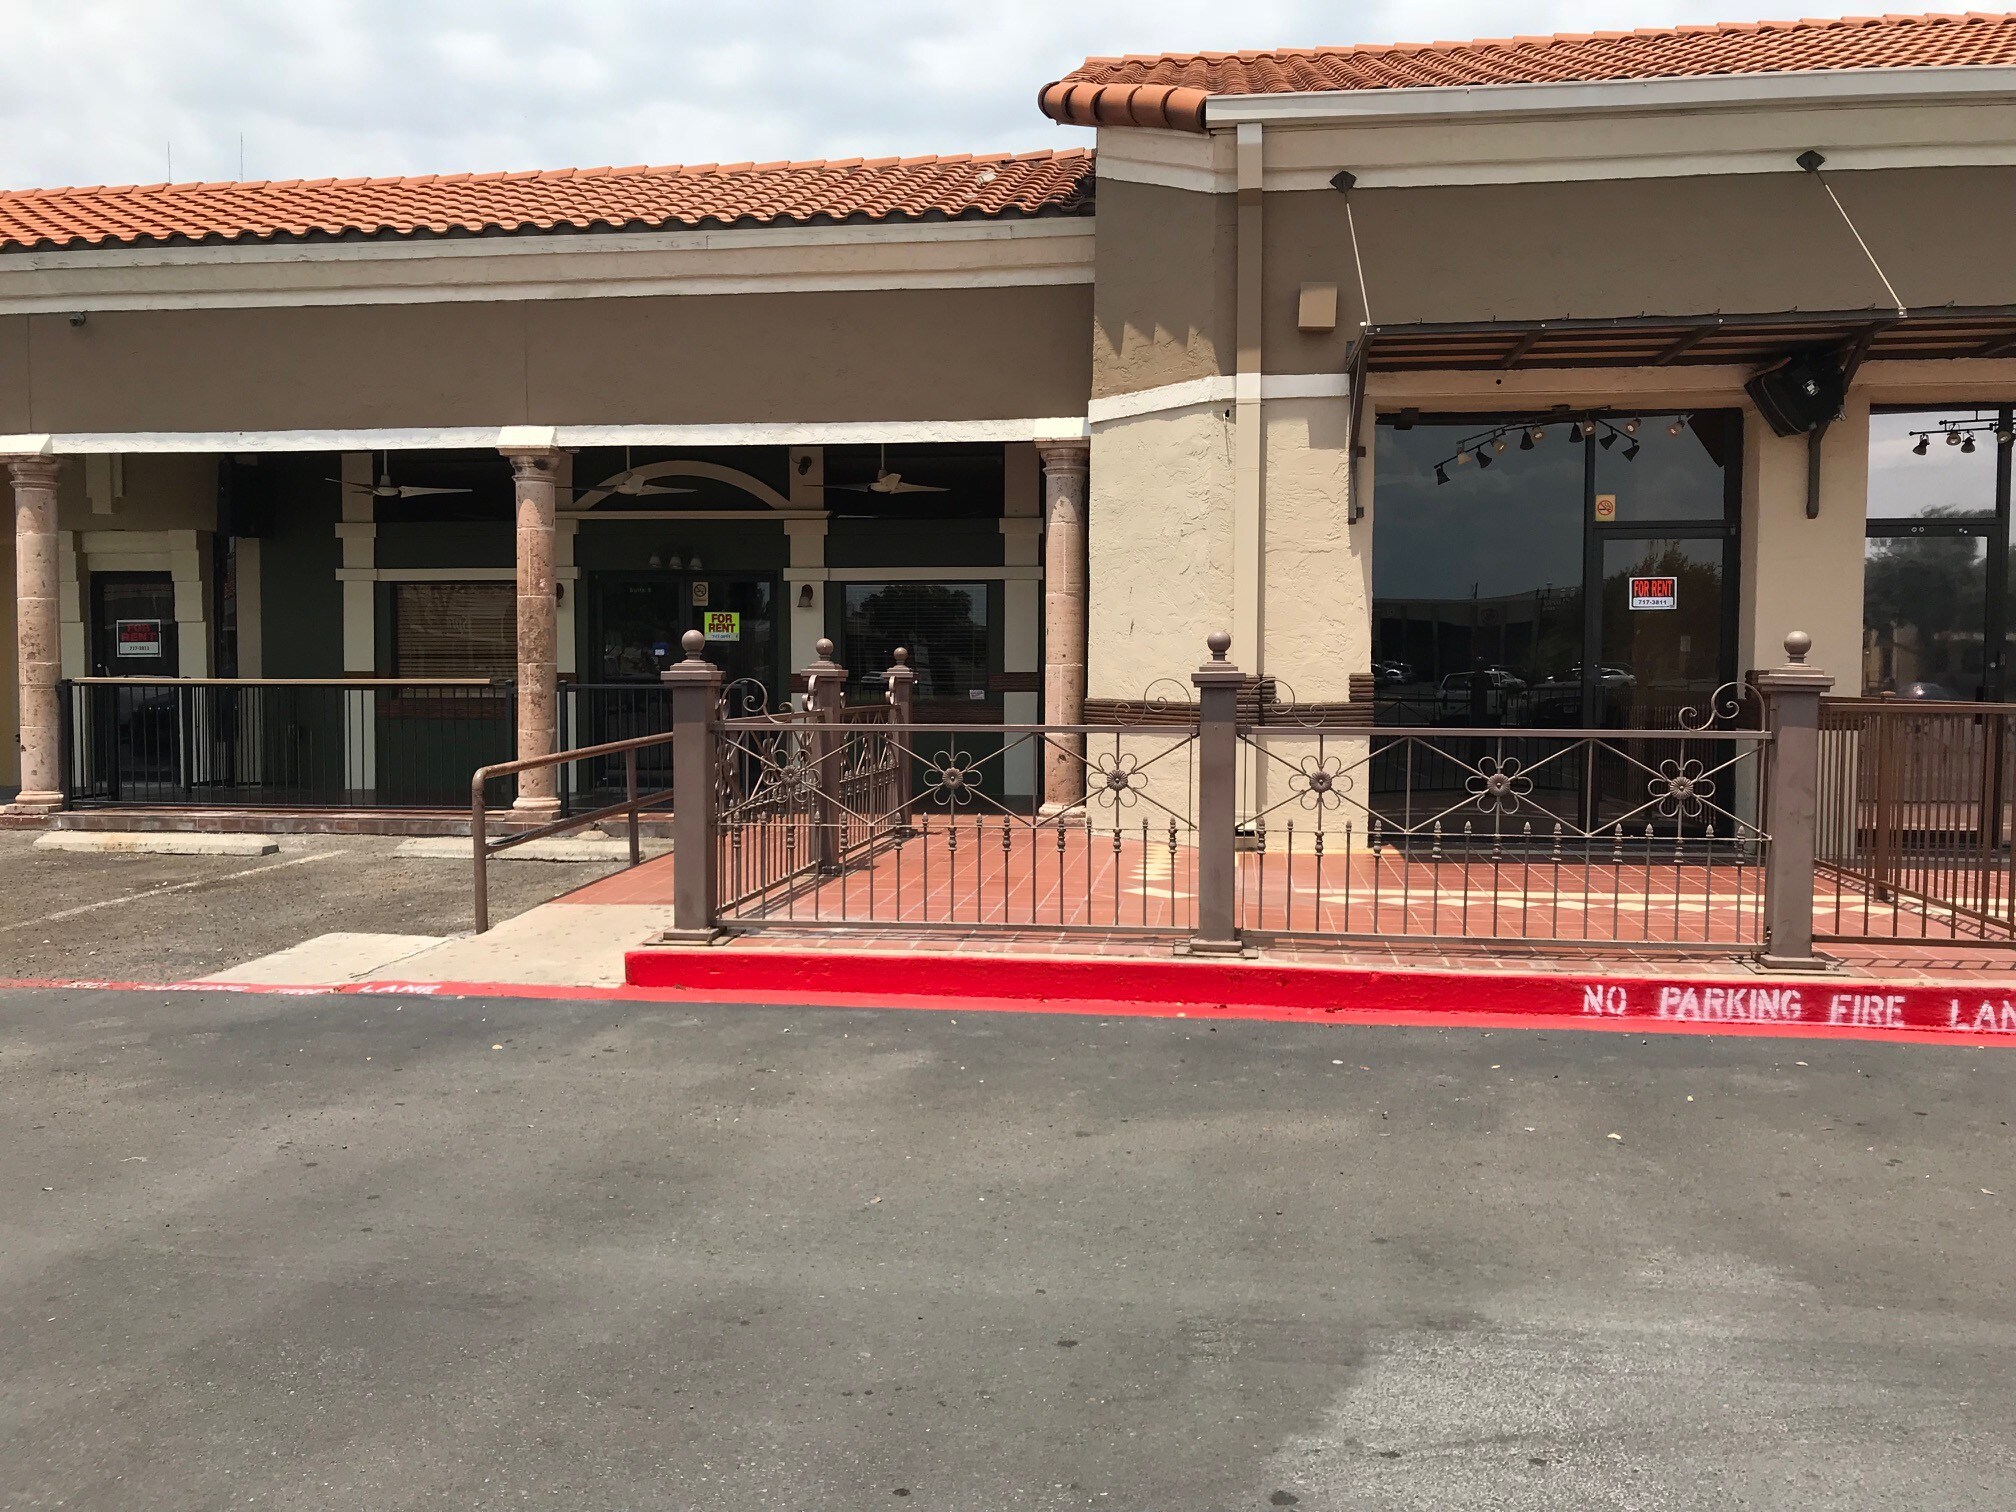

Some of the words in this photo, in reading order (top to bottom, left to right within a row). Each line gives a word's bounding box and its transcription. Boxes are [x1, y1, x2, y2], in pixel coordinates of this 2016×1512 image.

[1634, 580, 1650, 597] FOR
[1651, 579, 1673, 597] RENT
[711, 614, 733, 623] FOR
[126, 623, 151, 632] FOR
[708, 623, 736, 633] RENT
[121, 632, 156, 642] RENT
[1583, 984, 1627, 1015] NO
[1658, 986, 1802, 1020] PARKING
[1828, 994, 1906, 1026] FIRE
